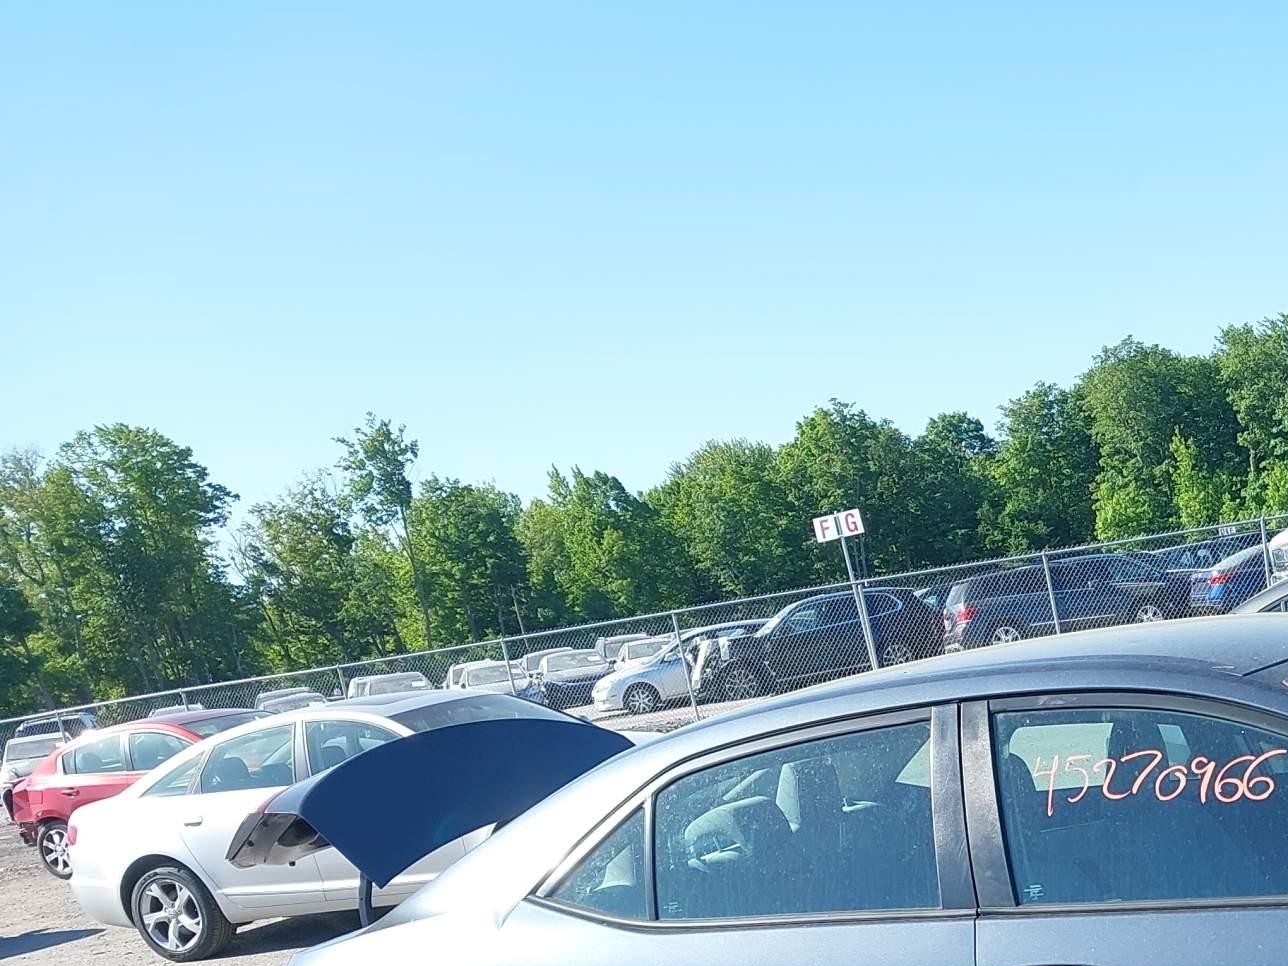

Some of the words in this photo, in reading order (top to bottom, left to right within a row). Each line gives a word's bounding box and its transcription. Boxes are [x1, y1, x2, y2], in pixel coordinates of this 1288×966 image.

[819, 519, 830, 539] F
[844, 512, 859, 533] G
[1032, 749, 1288, 816] 45270966
